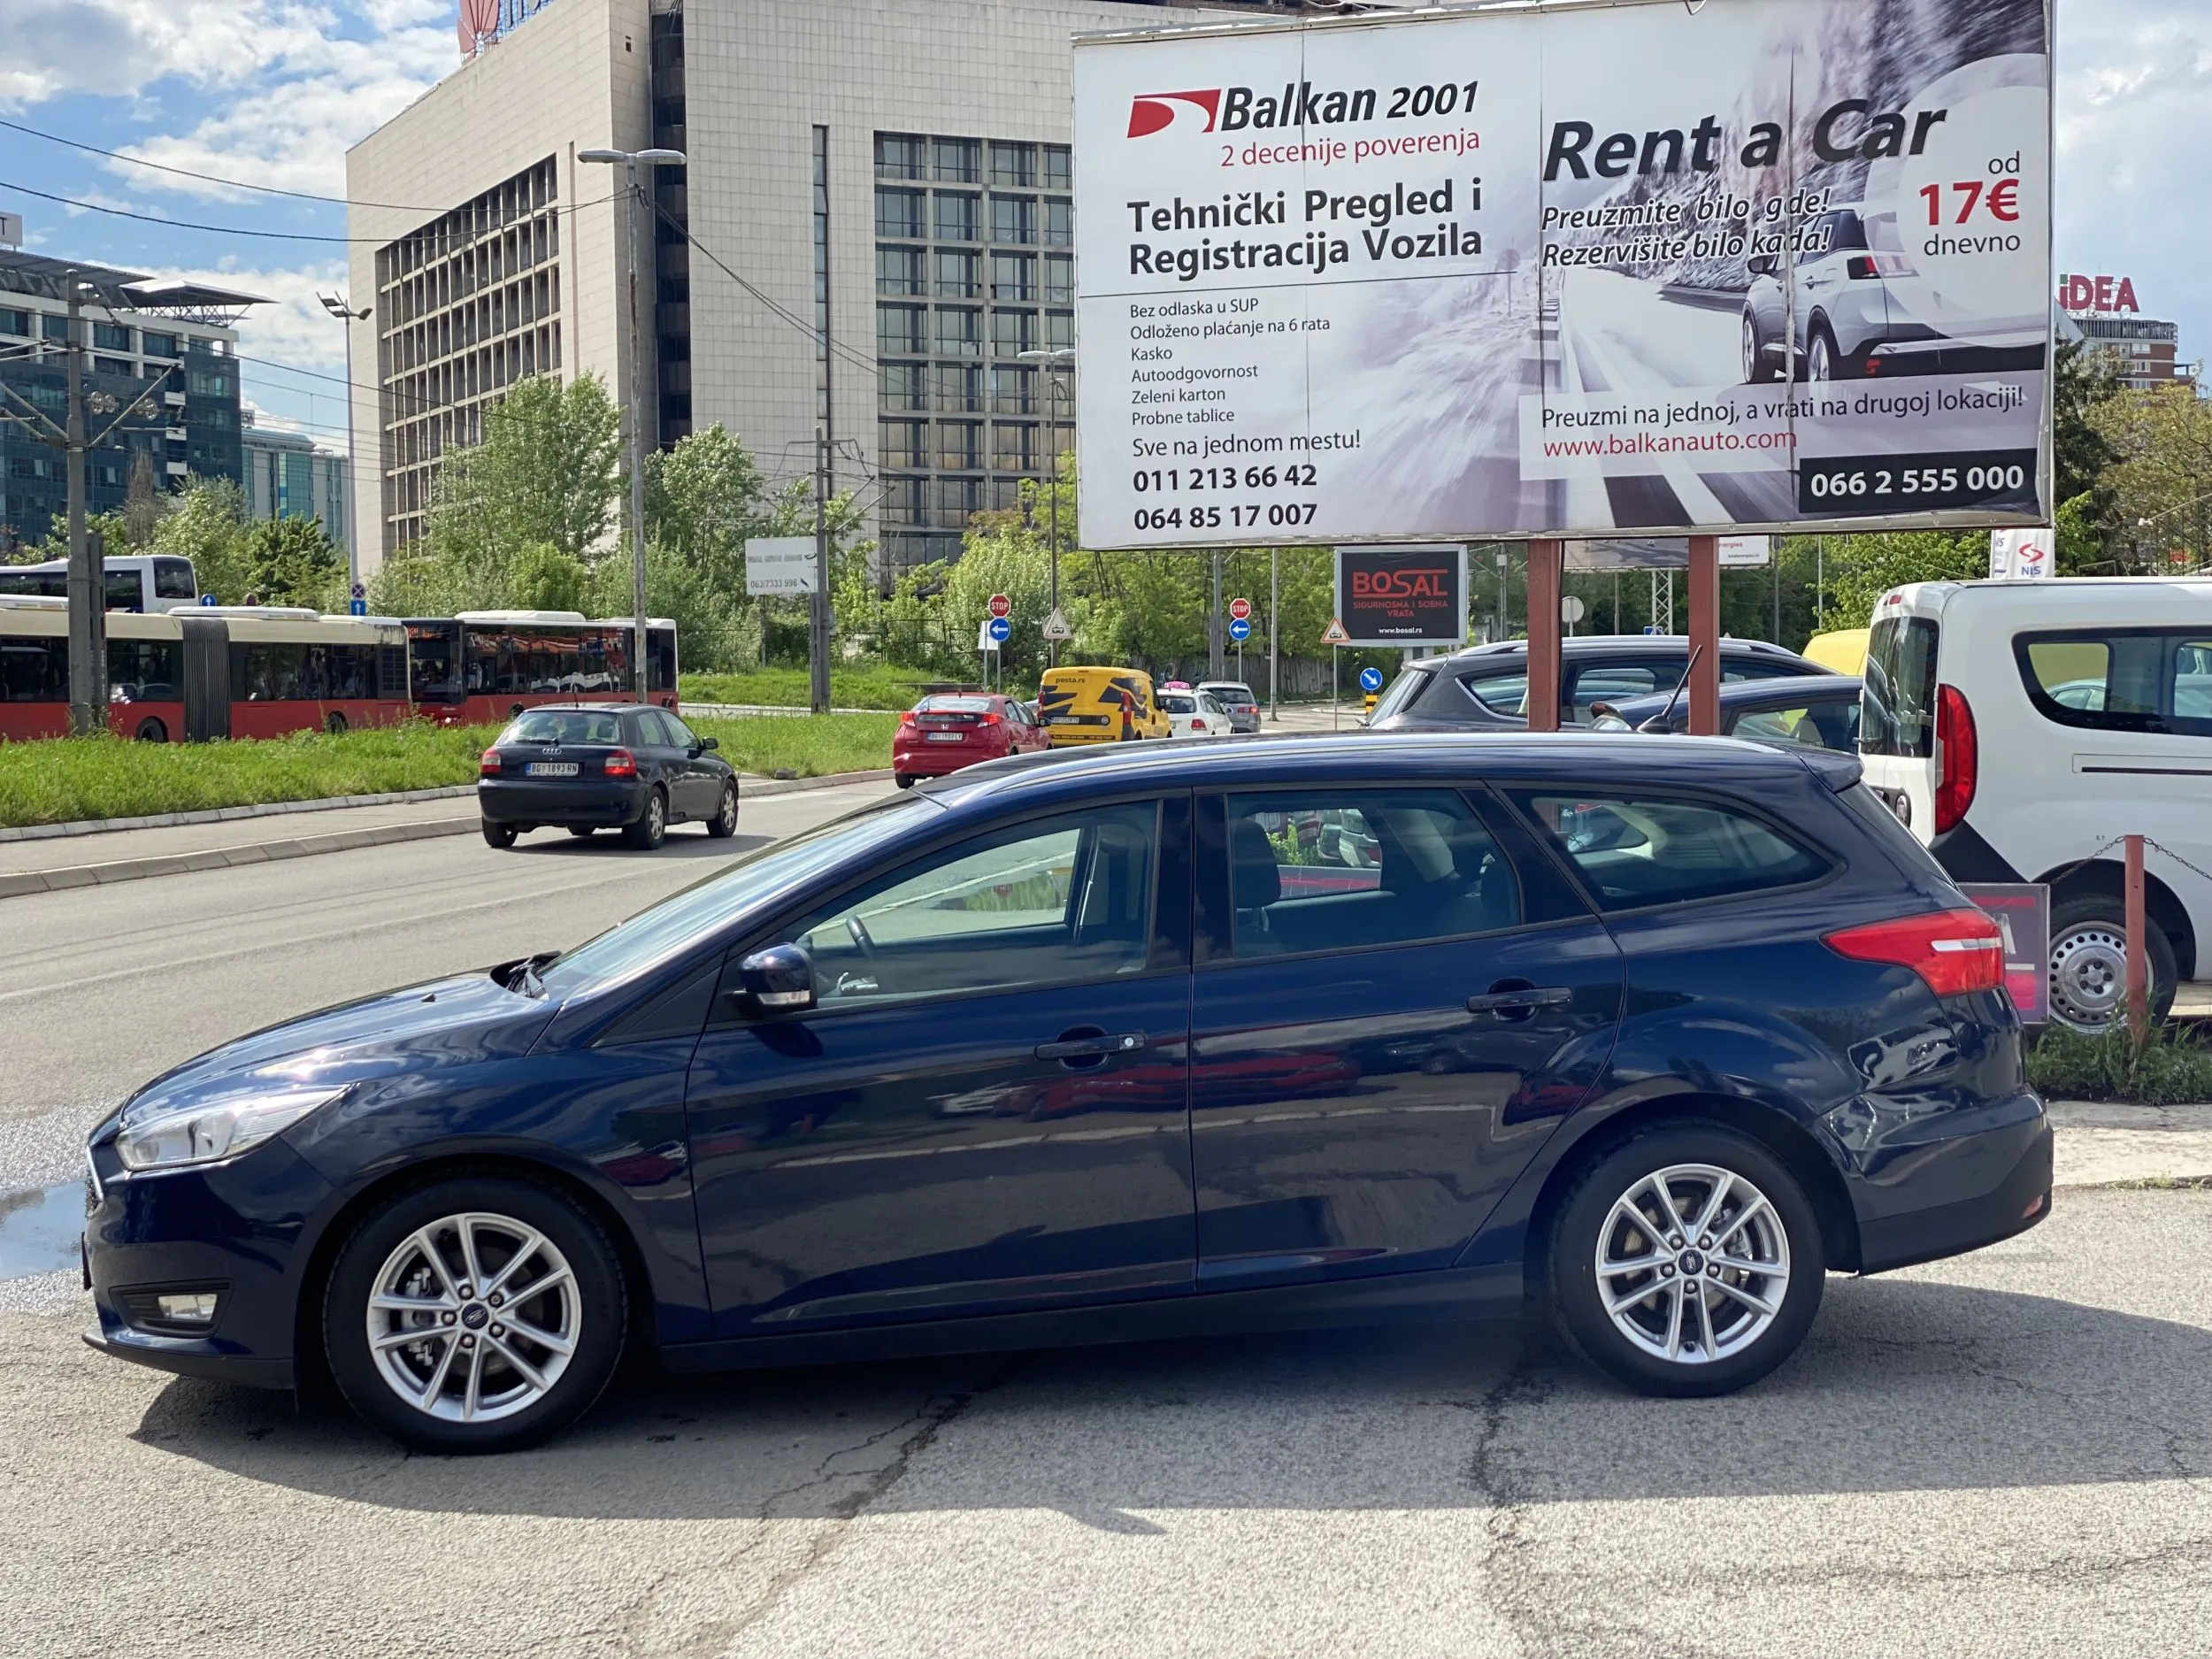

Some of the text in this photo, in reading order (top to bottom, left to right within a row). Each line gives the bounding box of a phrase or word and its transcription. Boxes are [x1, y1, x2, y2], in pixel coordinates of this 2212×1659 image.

[1221, 81, 1479, 131] Balkan 2001
[1221, 128, 1480, 166] 2 decenije poverenja
[1542, 98, 1948, 181] Rent a Car
[1988, 150, 2020, 174] od
[1127, 177, 1482, 232] Tehnički Pregled i
[1542, 188, 1830, 231] Preuzmite bilo gde!
[1919, 178, 2020, 226] 17€
[1130, 222, 1482, 281] Registracija Vozila
[1542, 224, 1830, 267] Rezervišite bilo kada!
[1924, 232, 2021, 257] dnevno
[1130, 298, 1259, 319] Bez odlaska u SUP
[1130, 318, 1330, 340] Odloženo plaćanje na 6 rata
[1131, 346, 1173, 361] Kasko
[1131, 365, 1258, 385] Autoodgovornost
[1131, 387, 1225, 404] Zeleni karton
[1542, 385, 2024, 429] Preuzmi na jednoj, a vrati na drugoj lokaciji!
[1132, 408, 1234, 426] Probne tablice
[1133, 429, 1361, 460] Sve na jednom mestu!
[1543, 430, 1797, 457] www.balkanauto.com
[1133, 464, 1317, 492] 011 213 66 42
[1810, 465, 2024, 498] 066 2 555 000
[1134, 503, 1317, 530] 064 85 17 007
[1352, 569, 1448, 598] BOSAL
[2021, 565, 2041, 575] NIS
[991, 602, 1009, 611] STOP
[1386, 609, 1415, 618] VRATA
[532, 764, 578, 772] BG 1893 RN
